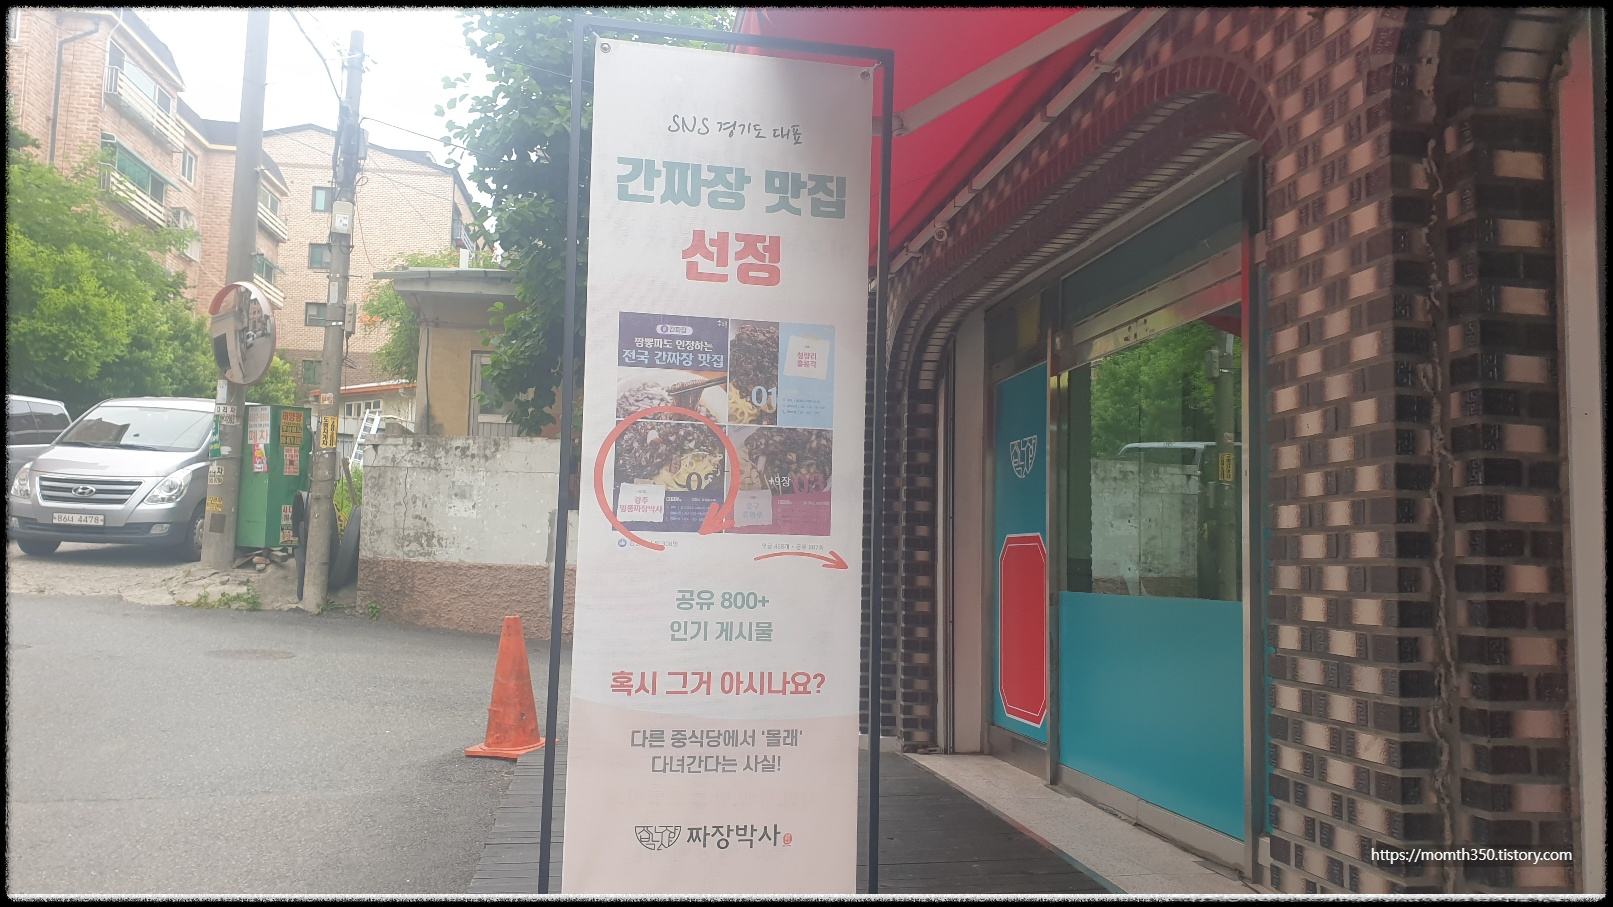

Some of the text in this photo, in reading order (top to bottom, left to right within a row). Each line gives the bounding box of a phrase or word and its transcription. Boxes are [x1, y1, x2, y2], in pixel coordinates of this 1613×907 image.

[668, 114, 803, 145] SNS 경기도 대표
[616, 156, 847, 219] 간짜장 맛집
[681, 229, 781, 287] 선정
[635, 337, 713, 352] 짬뽕파도 인정하는
[622, 349, 724, 368] 전국 간짜장 맛집
[675, 589, 770, 611] 공유 800+
[670, 620, 774, 642] 인기 게시물
[610, 670, 826, 697] 혹시 그거 아시나요?
[630, 729, 802, 748] 다른 중식당에서 '몰래'
[651, 754, 781, 774] 다녀간다는 사실!
[686, 824, 781, 850] 짜장박사
